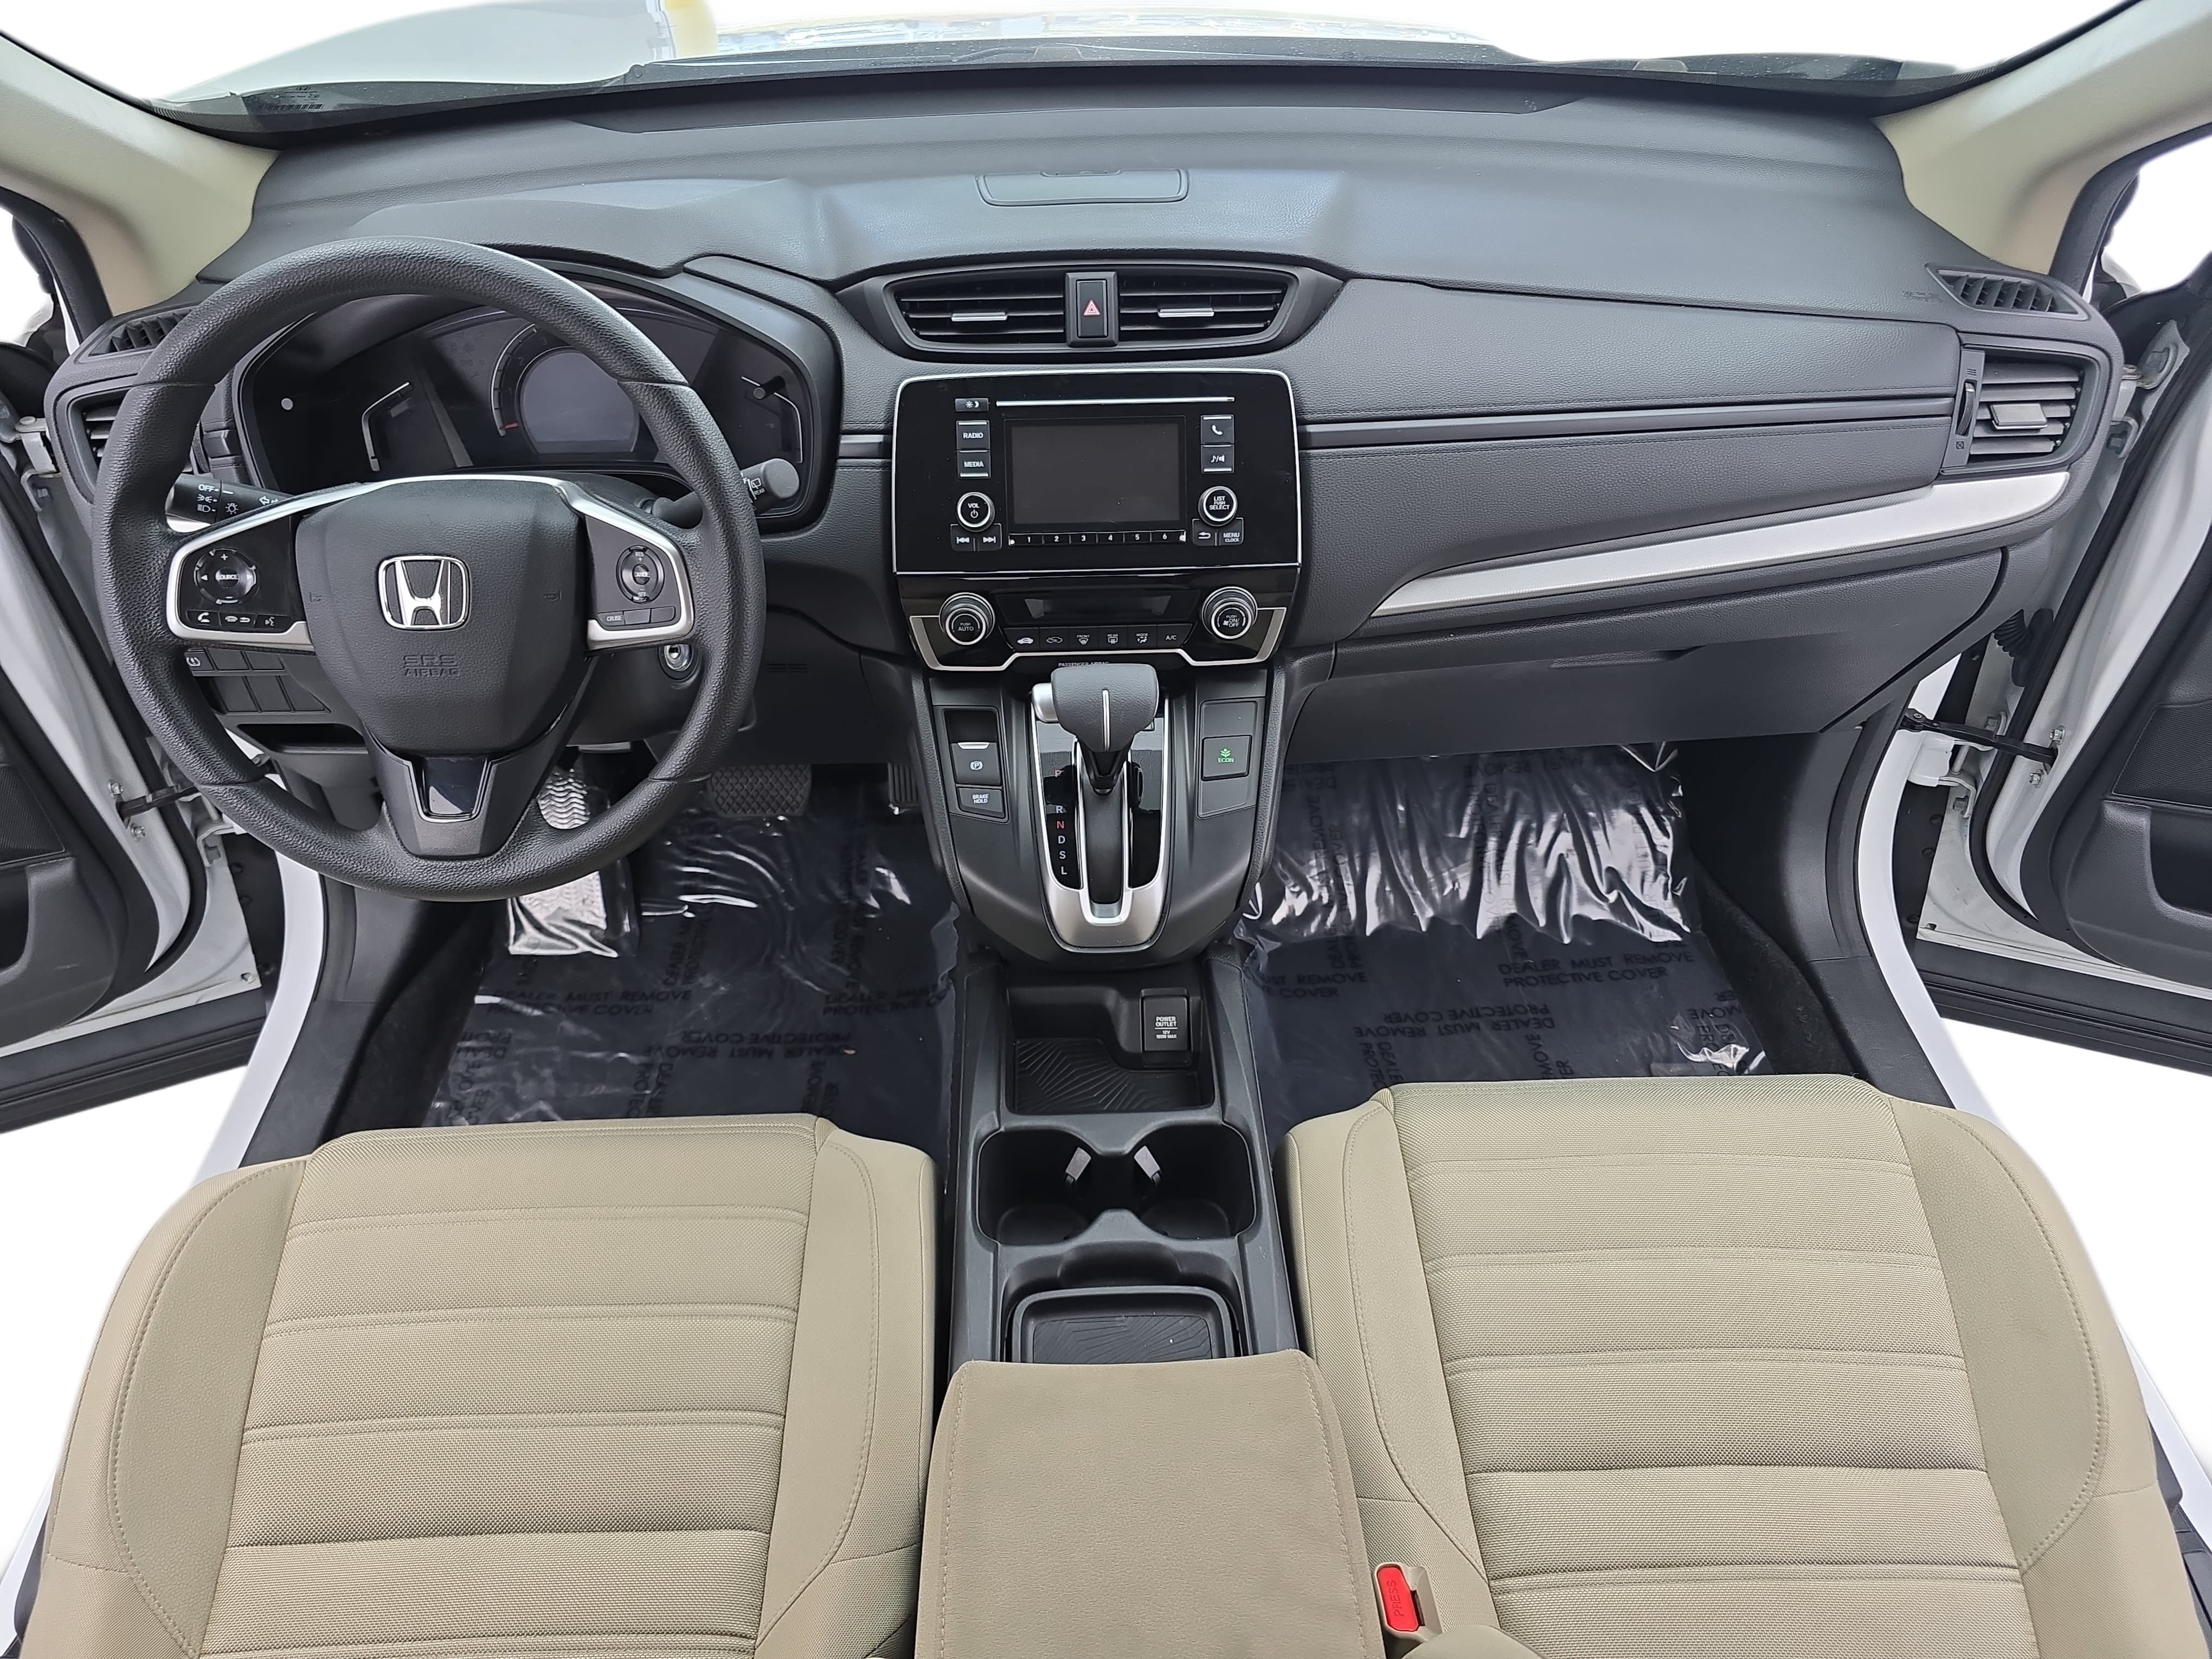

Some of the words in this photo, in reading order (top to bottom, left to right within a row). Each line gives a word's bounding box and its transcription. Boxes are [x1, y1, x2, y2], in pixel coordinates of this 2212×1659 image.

[198, 484, 215, 492] OFF
[403, 655, 460, 666] SRS
[1057, 821, 1064, 829] N
[1308, 795, 1328, 859] REMOVE
[1058, 835, 1065, 844] D
[1059, 851, 1066, 859] S
[1061, 866, 1068, 875] L
[1497, 959, 1561, 975] DEALER
[1571, 956, 1613, 969] MUST
[1623, 950, 1695, 965] REMOVE
[1296, 972, 1367, 985] REMOVE
[1503, 971, 1604, 987] PROTECTIVE
[1608, 966, 1669, 980] COVER
[565, 991, 611, 1003] MUST
[620, 989, 693, 1003] REMOVE
[1280, 987, 1341, 998] COVER
[594, 1004, 655, 1017] COVER
[1447, 1002, 1551, 1020] PROTECTIVE
[1382, 1011, 1443, 1024] COVER
[1491, 1017, 1555, 1031] DEALER
[1354, 1025, 1427, 1038] REMOVE
[1438, 1021, 1481, 1036] MUST
[680, 1031, 743, 1044] COVER
[749, 1032, 851, 1044] PROTECTIVE
[730, 1045, 774, 1058] MUST
[1386, 1579, 1405, 1617] PRESS
